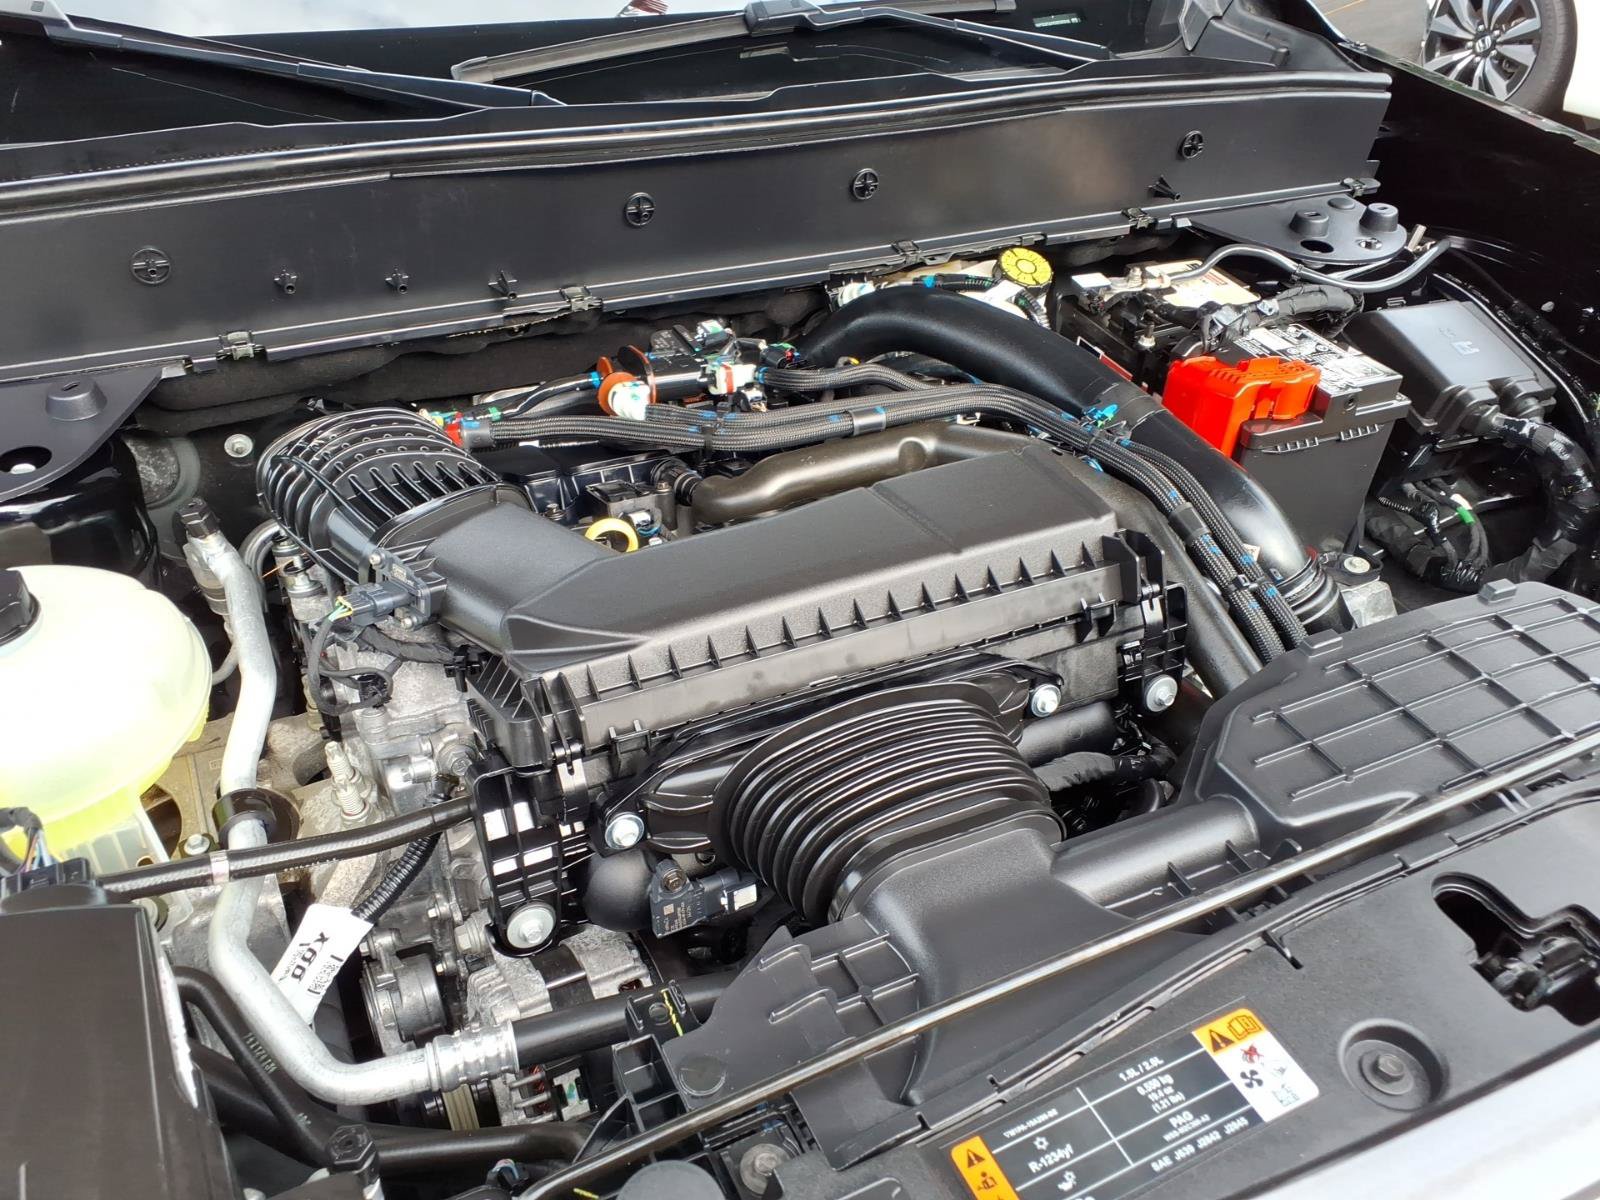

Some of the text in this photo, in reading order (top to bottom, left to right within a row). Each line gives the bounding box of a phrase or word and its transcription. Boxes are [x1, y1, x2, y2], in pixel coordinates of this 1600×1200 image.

[1169, 1110, 1194, 1128] PAG
[1028, 1143, 1074, 1173] R-1234yf
[1151, 1155, 1173, 1172] SAE
[1174, 1144, 1195, 1160] J639
